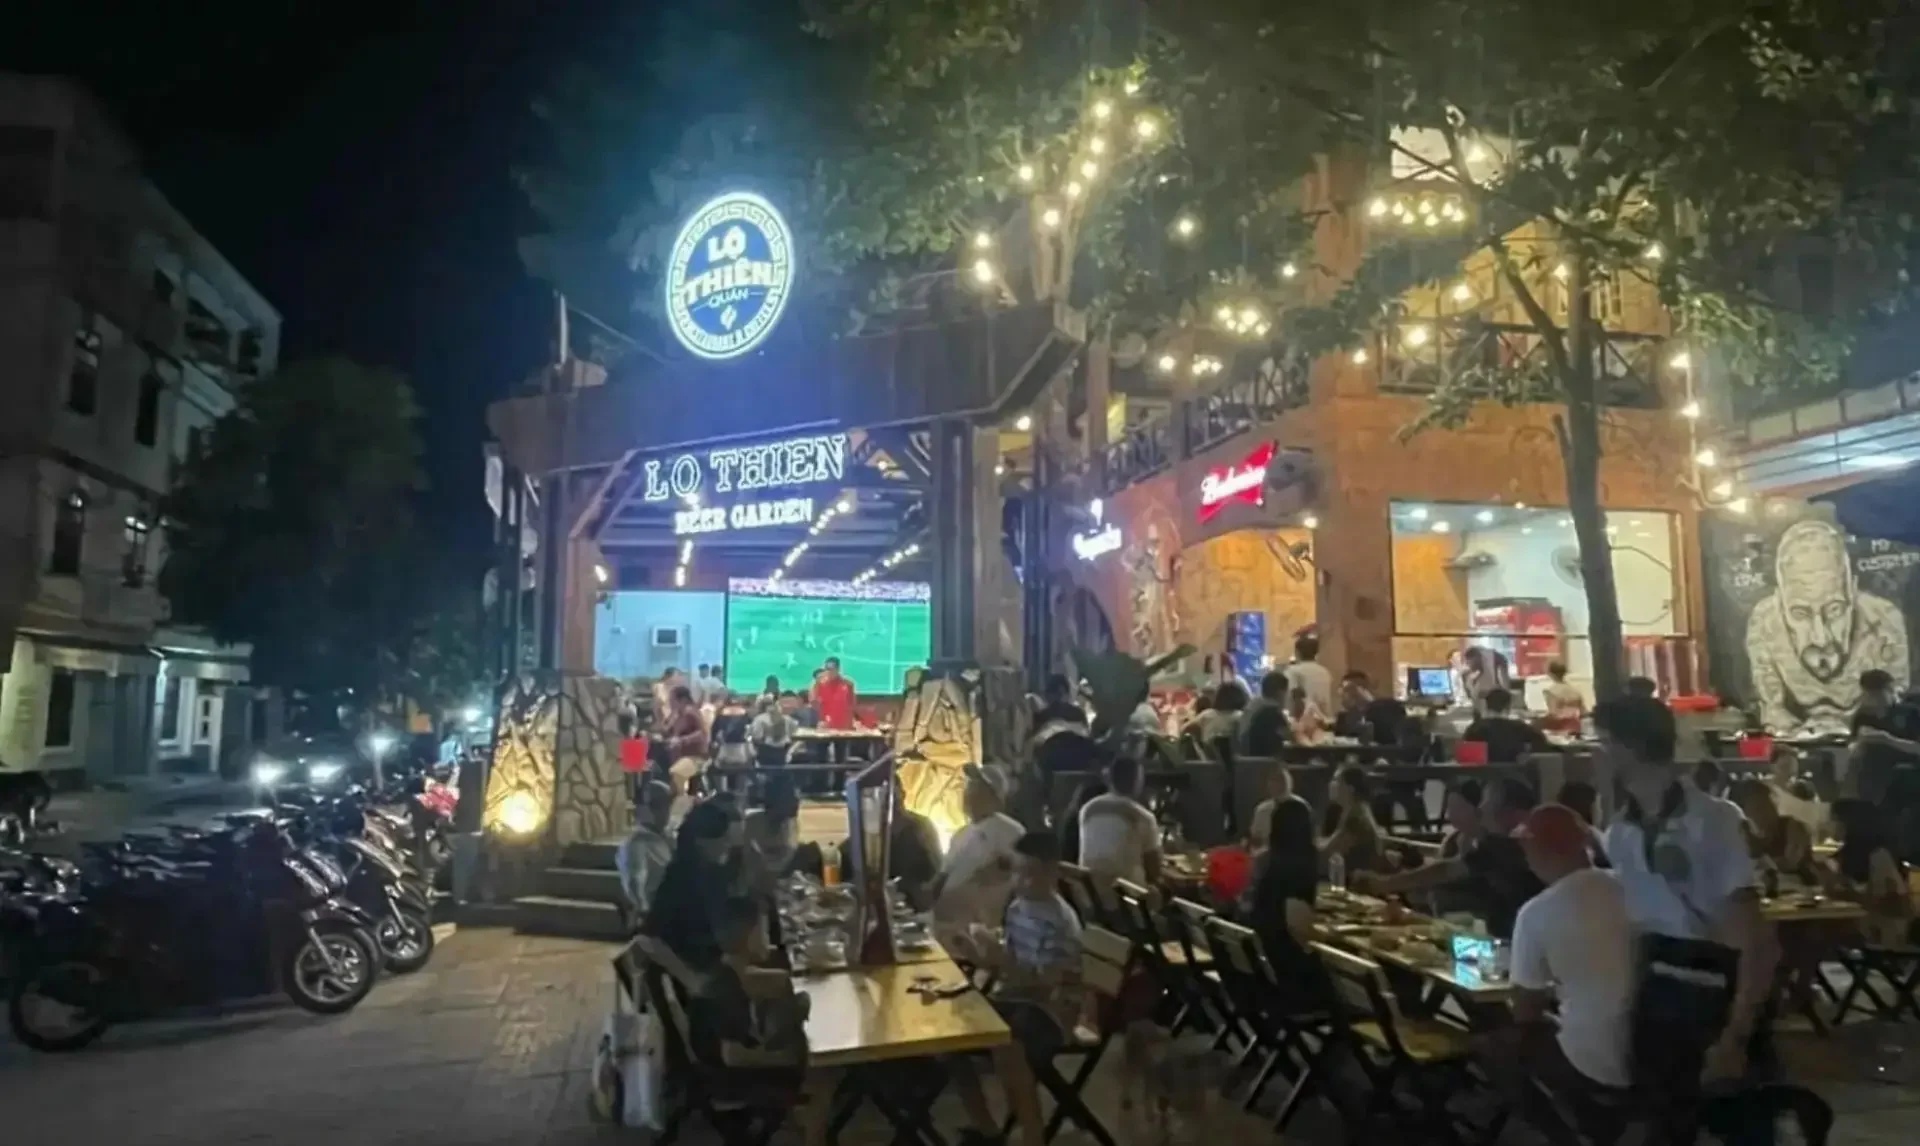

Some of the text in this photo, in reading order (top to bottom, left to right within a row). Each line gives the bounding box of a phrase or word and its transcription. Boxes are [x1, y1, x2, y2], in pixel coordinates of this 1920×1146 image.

[644, 433, 846, 501] LO THIEN
[674, 498, 813, 534] BEER GARDEN
